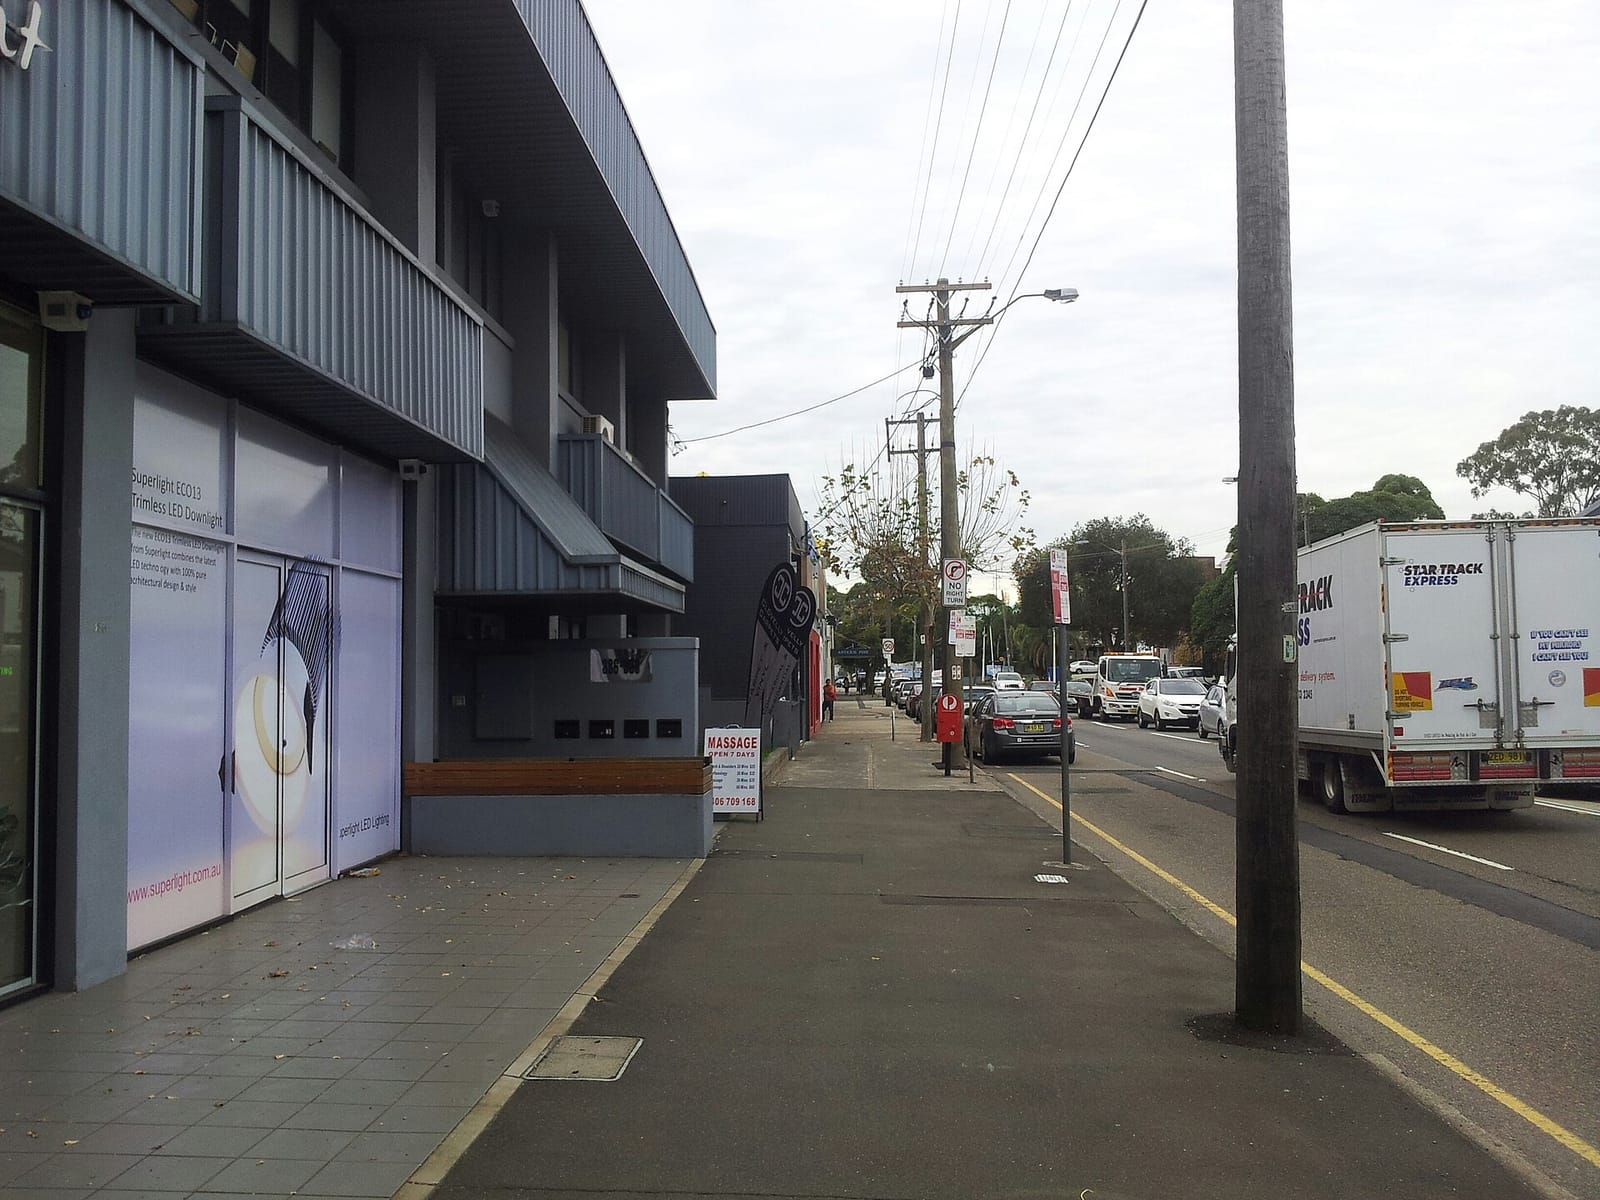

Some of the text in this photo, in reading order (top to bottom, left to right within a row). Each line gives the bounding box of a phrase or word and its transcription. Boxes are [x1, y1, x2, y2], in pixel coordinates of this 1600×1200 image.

[131, 467, 202, 501] Superlight ECO13
[131, 492, 223, 529] Trimless LED Downlight
[154, 532, 171, 544] ECO13
[145, 545, 171, 560] Superlight
[171, 552, 194, 563] combines
[194, 555, 203, 564] the
[204, 555, 216, 566] latest
[170, 567, 181, 575] with
[182, 568, 195, 578] 100%
[196, 571, 207, 580] pure
[1439, 562, 1484, 575] TRACK
[163, 579, 179, 592] design
[185, 583, 197, 593] style
[948, 582, 962, 590] NO
[1404, 575, 1459, 586] EXPRESS
[1538, 630, 1553, 639] YOU
[708, 736, 758, 749] MASSAGE
[726, 797, 740, 806] 709
[742, 797, 756, 806] 168
[339, 813, 389, 840] perlight LED Lighting
[127, 863, 221, 904] www.superlight.com.au
